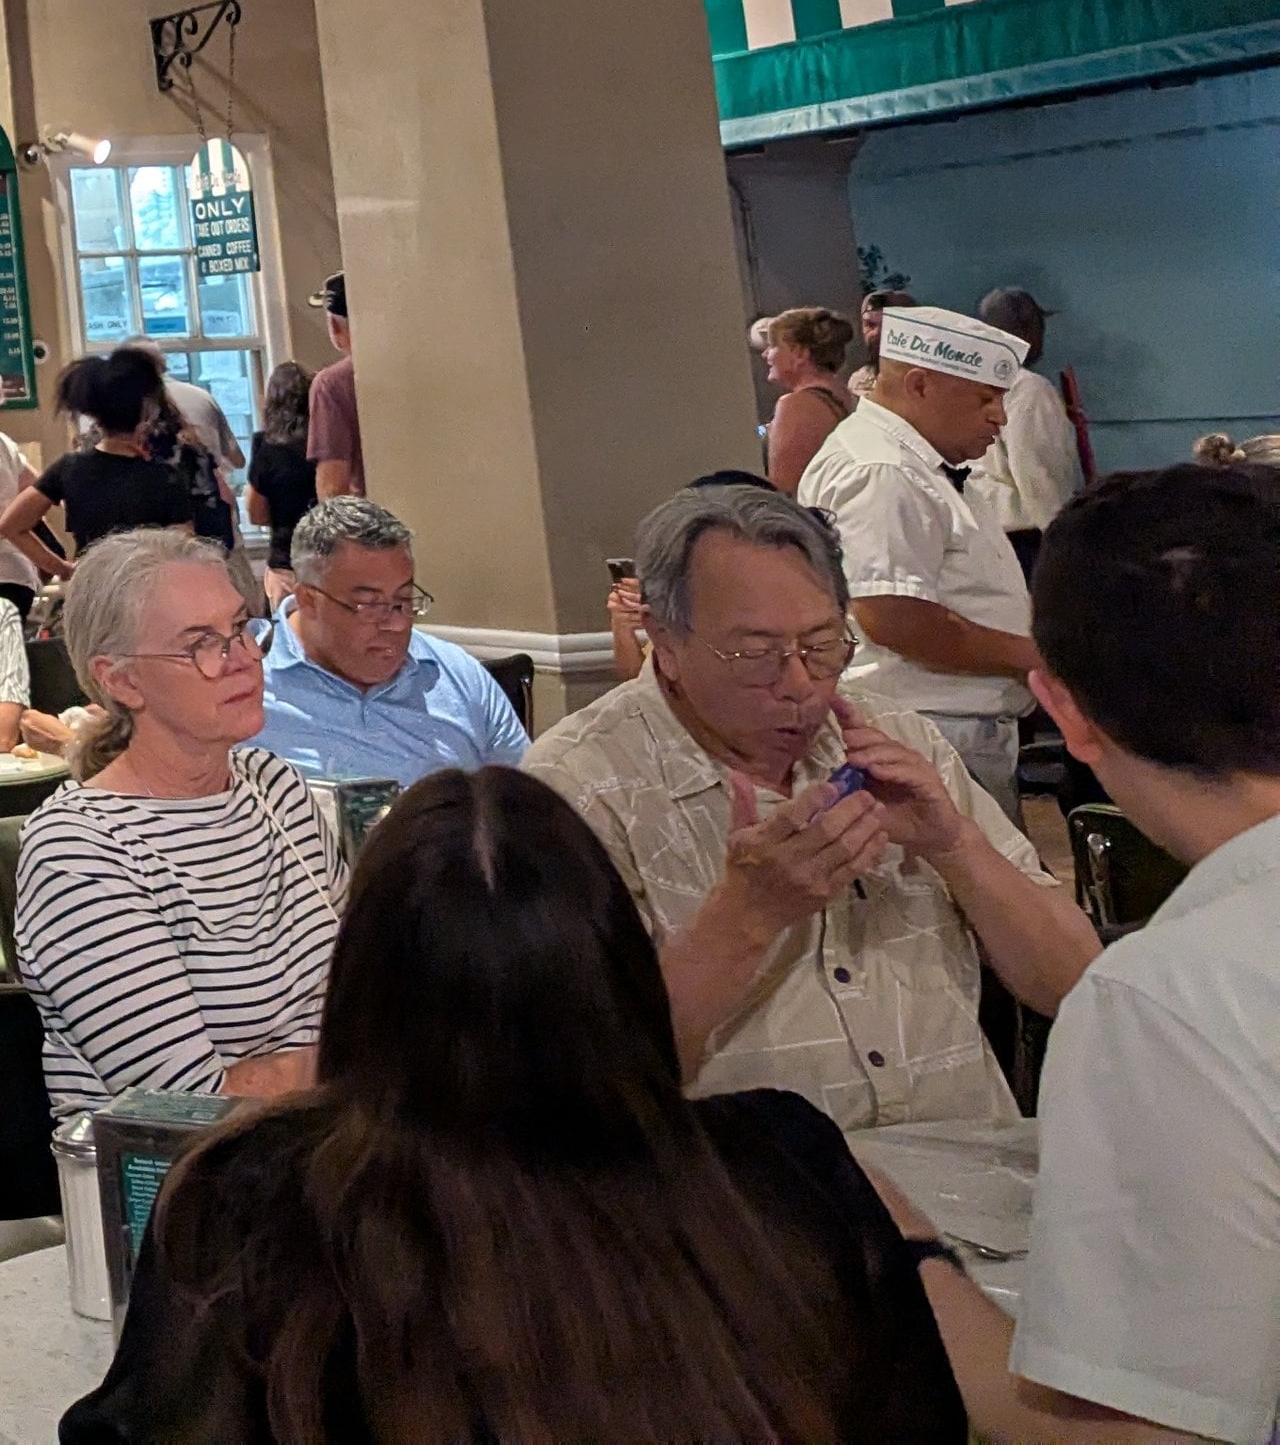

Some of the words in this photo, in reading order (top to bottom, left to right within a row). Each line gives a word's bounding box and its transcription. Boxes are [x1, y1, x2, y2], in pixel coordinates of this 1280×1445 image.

[195, 196, 245, 220] ONLY
[88, 320, 105, 330] ASH
[887, 329, 907, 349] Café
[910, 334, 930, 354] Du
[934, 341, 983, 368] Monde
